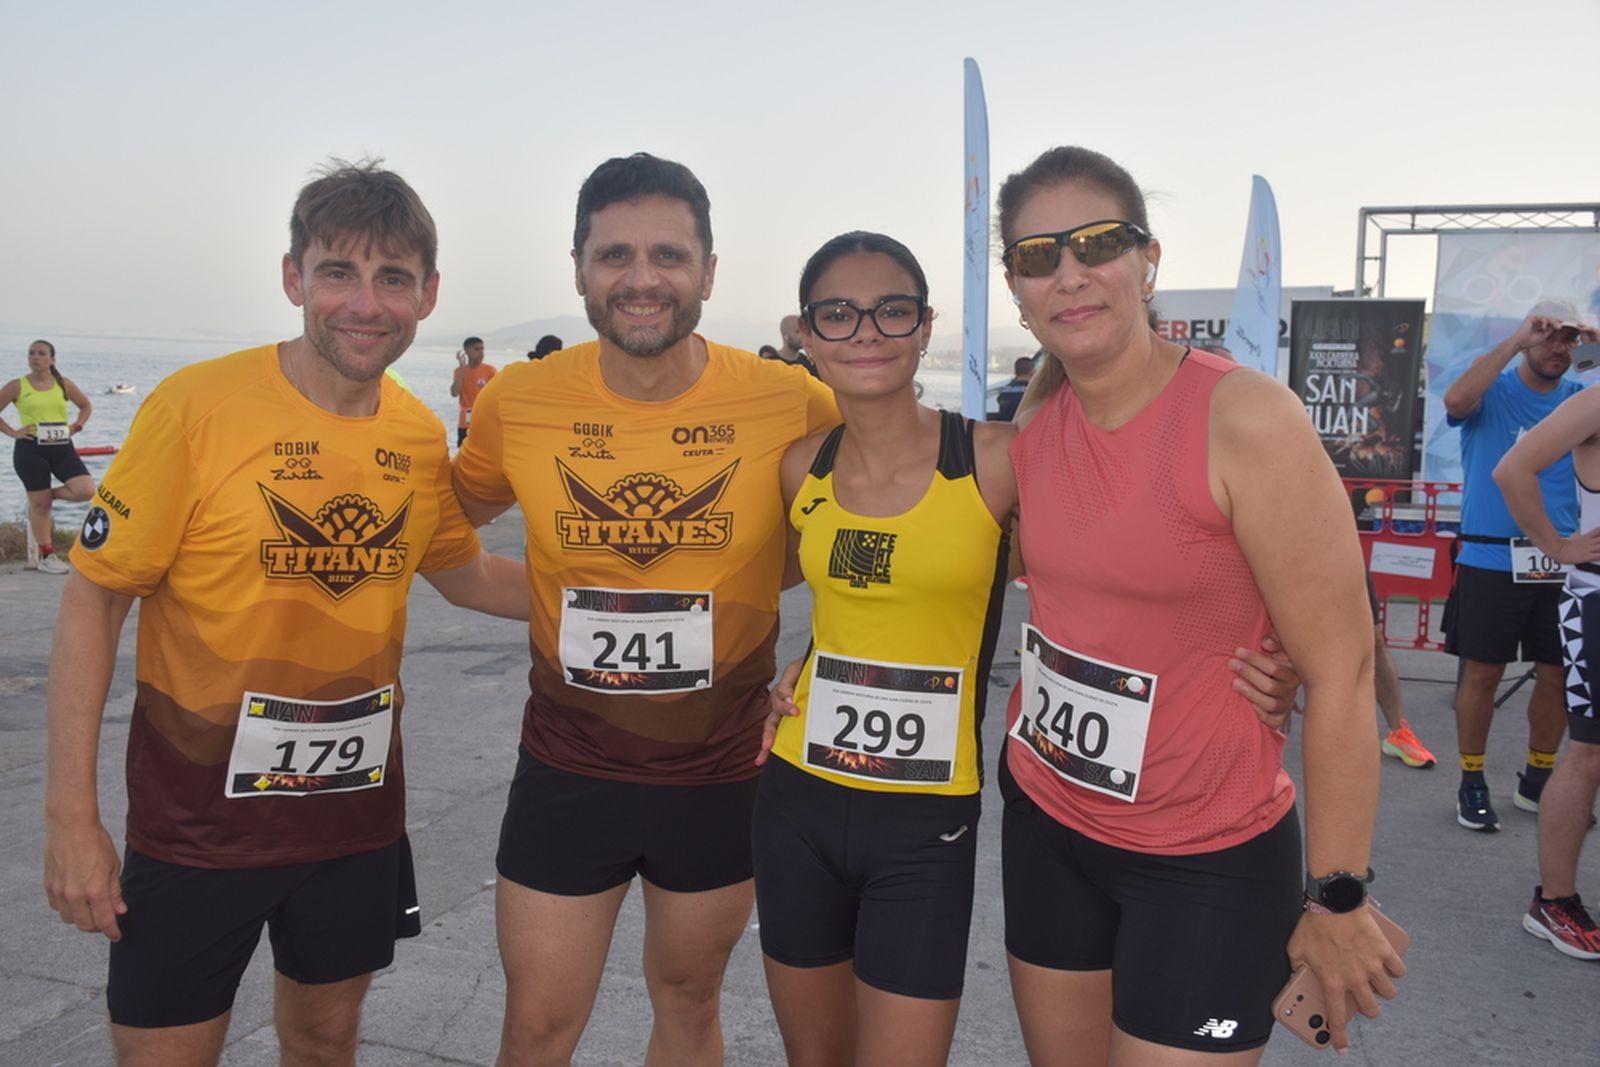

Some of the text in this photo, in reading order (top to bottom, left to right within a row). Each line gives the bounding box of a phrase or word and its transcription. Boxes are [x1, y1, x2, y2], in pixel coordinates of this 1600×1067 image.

[1305, 374, 1357, 404] SAN
[573, 422, 614, 438] GOBIK
[274, 441, 320, 456] GOBIK
[567, 446, 616, 460] Zurita
[683, 449, 714, 457] CEUTA
[270, 468, 324, 481] Zurita
[561, 519, 728, 546] TITANES
[267, 545, 407, 575] TITANES
[628, 546, 659, 555] BIKE
[327, 574, 356, 584] BIKE
[592, 630, 682, 671] 241
[262, 699, 318, 723] UAN
[1034, 685, 1110, 760] 240
[832, 704, 926, 757] 299
[269, 735, 365, 774] 179
[904, 759, 950, 781] SAN
